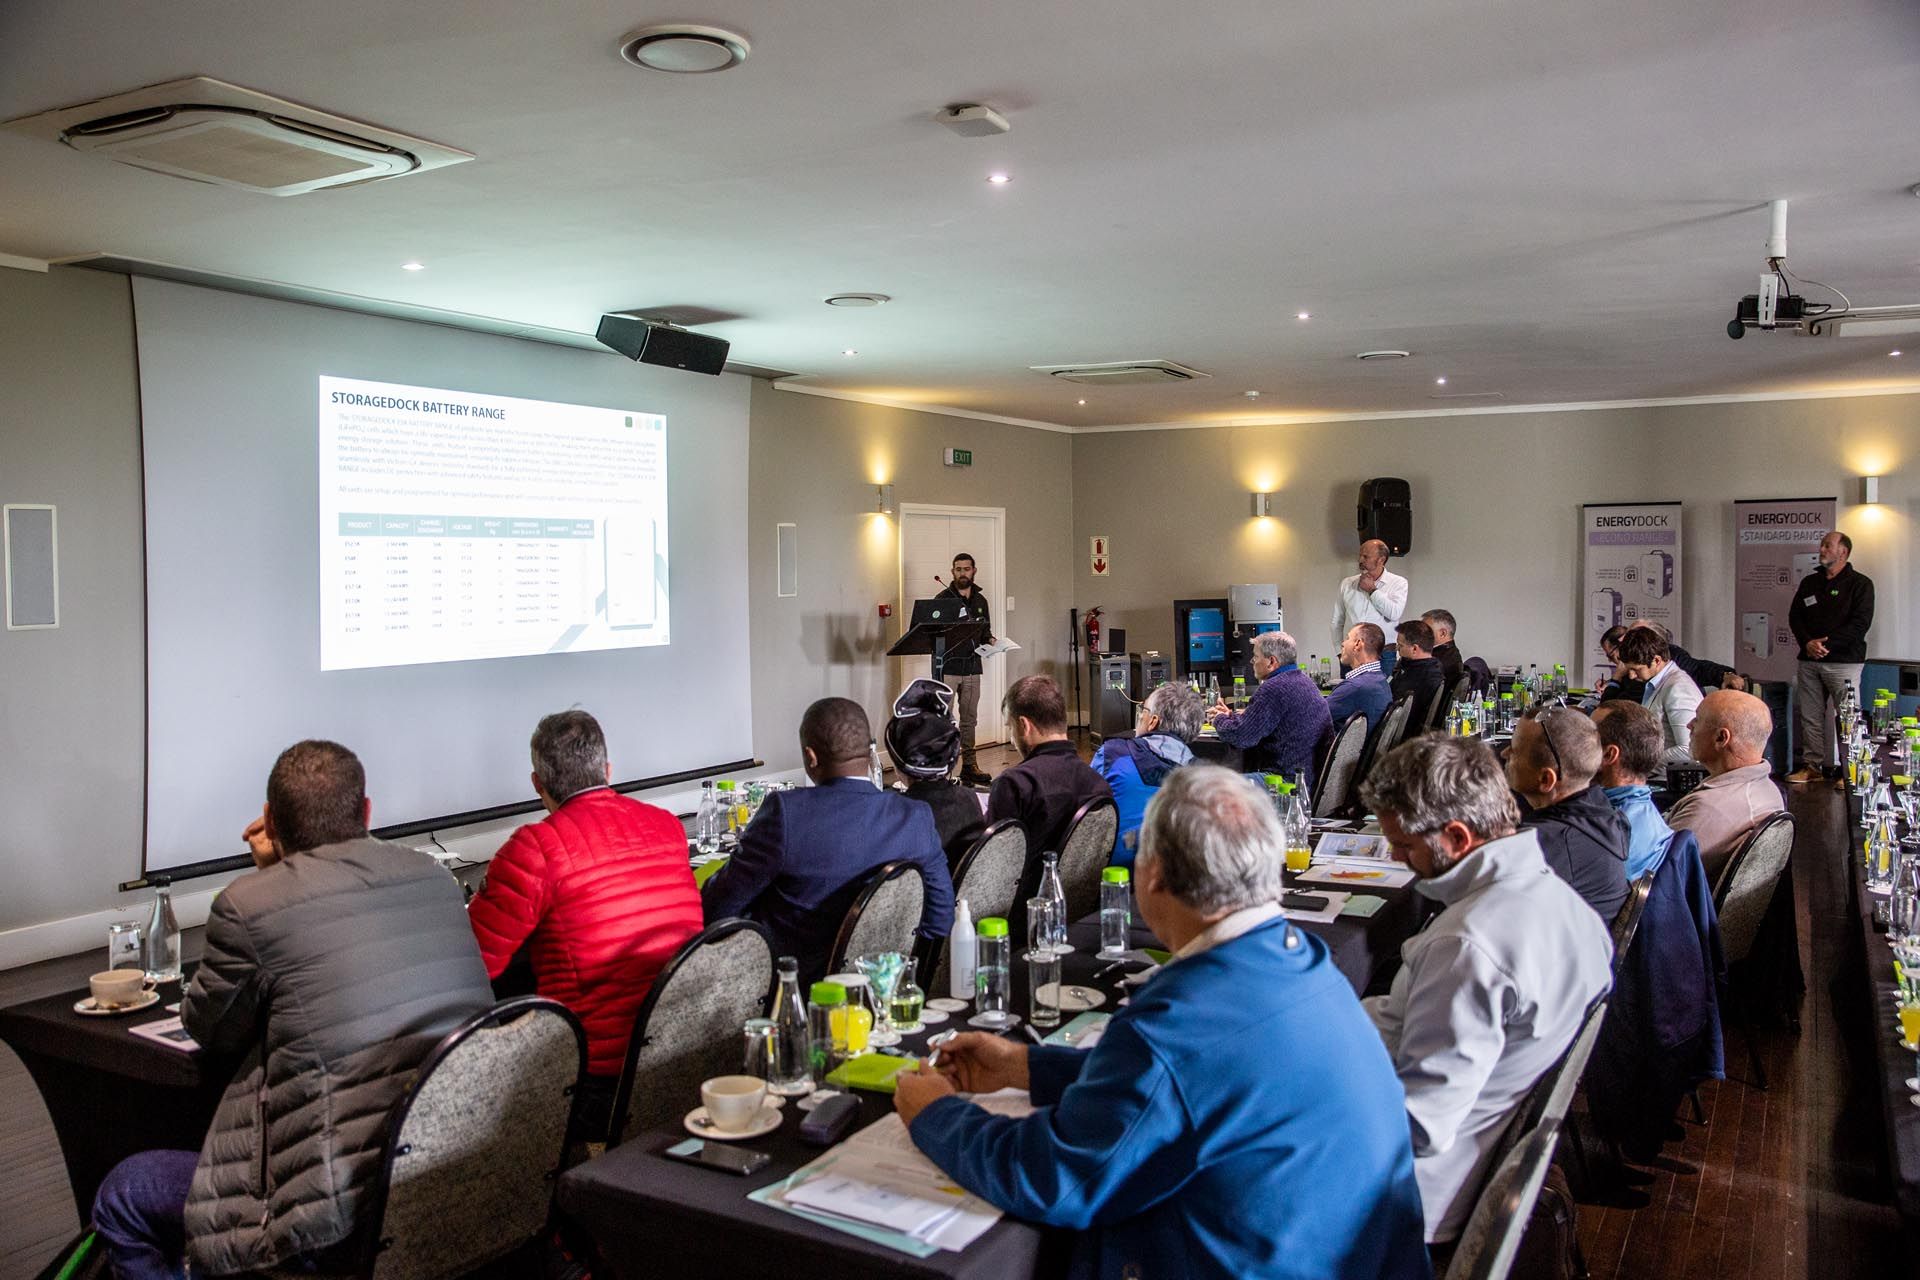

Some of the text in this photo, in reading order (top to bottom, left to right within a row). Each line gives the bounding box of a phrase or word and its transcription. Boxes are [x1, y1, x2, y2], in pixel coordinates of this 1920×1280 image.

[331, 391, 506, 420] STORAGEDOCK BATTERY RANGE
[955, 452, 971, 462] EXIT
[1596, 515, 1668, 527] ENERGYDOCK
[1748, 512, 1822, 525] ENERGYDOCK
[1778, 635, 1788, 643] 02
